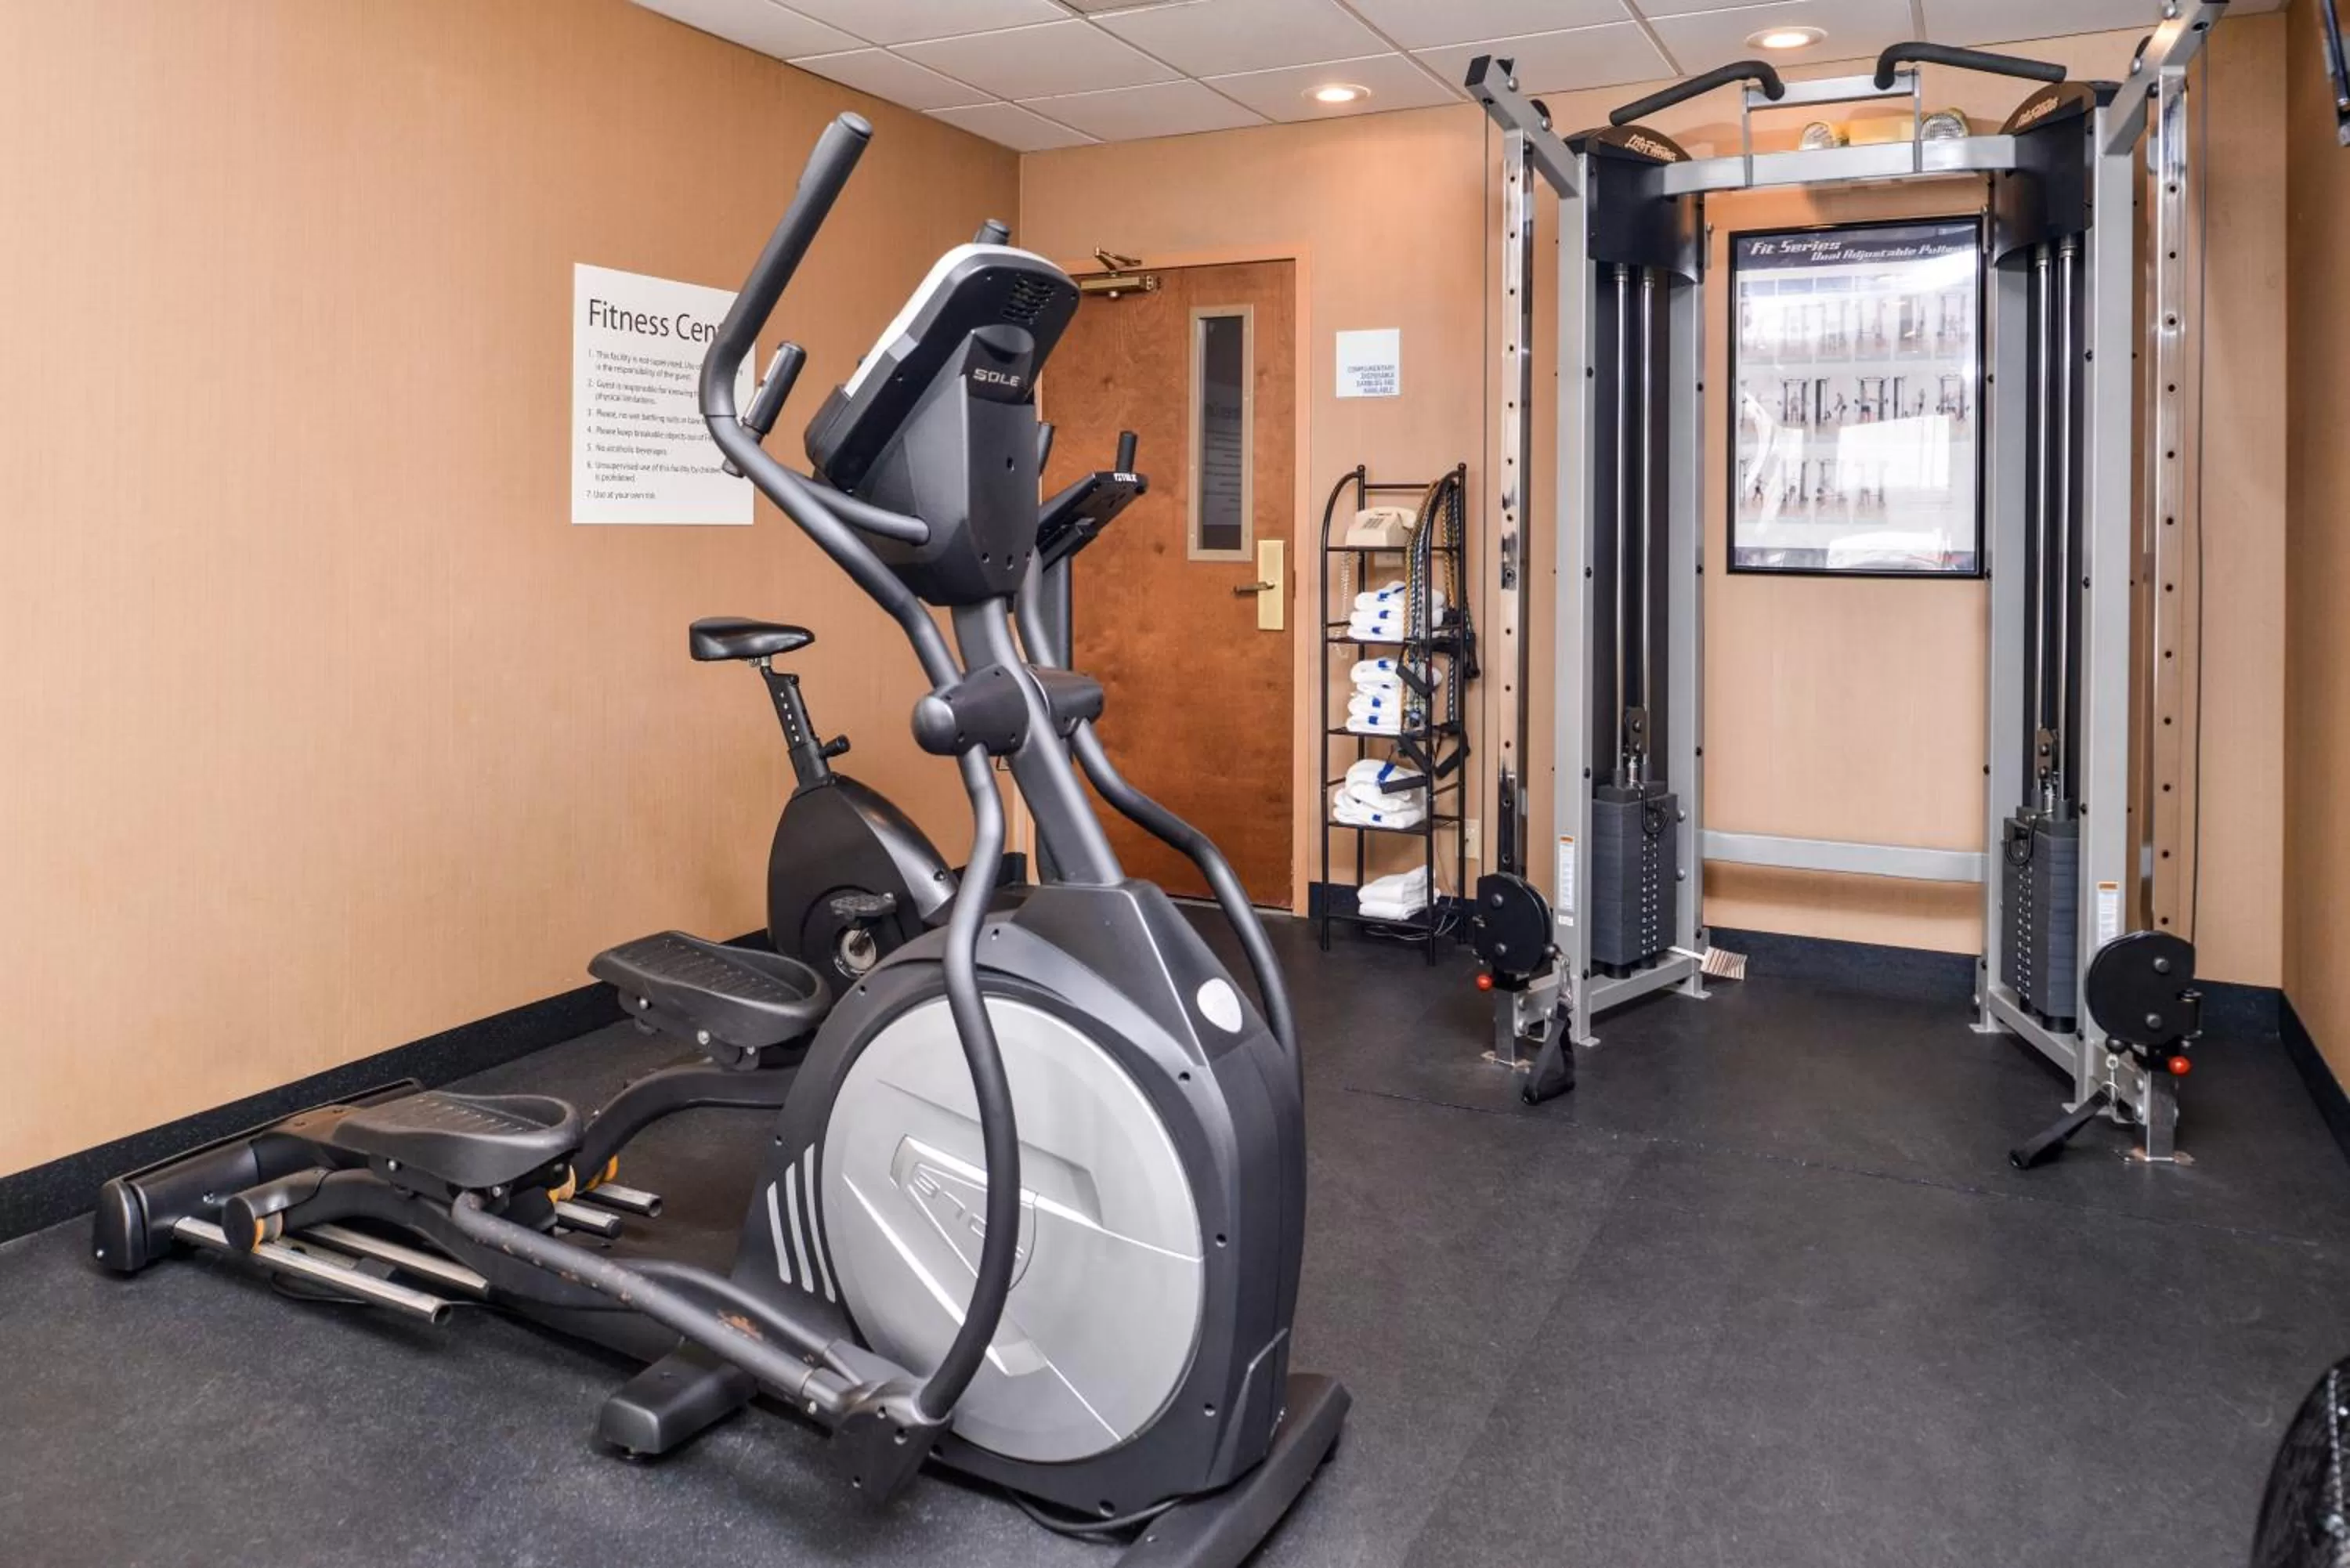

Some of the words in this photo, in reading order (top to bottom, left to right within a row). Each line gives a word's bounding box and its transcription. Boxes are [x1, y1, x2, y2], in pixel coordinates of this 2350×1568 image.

[1751, 240, 1775, 255] Fit
[1779, 239, 1842, 253] Series
[1811, 251, 1841, 261] Dual
[1842, 247, 1917, 261] Adjustable
[589, 298, 670, 337] Fitness
[676, 313, 724, 342] Cen
[613, 365, 655, 378] responsibility
[973, 368, 1021, 387] SOLE
